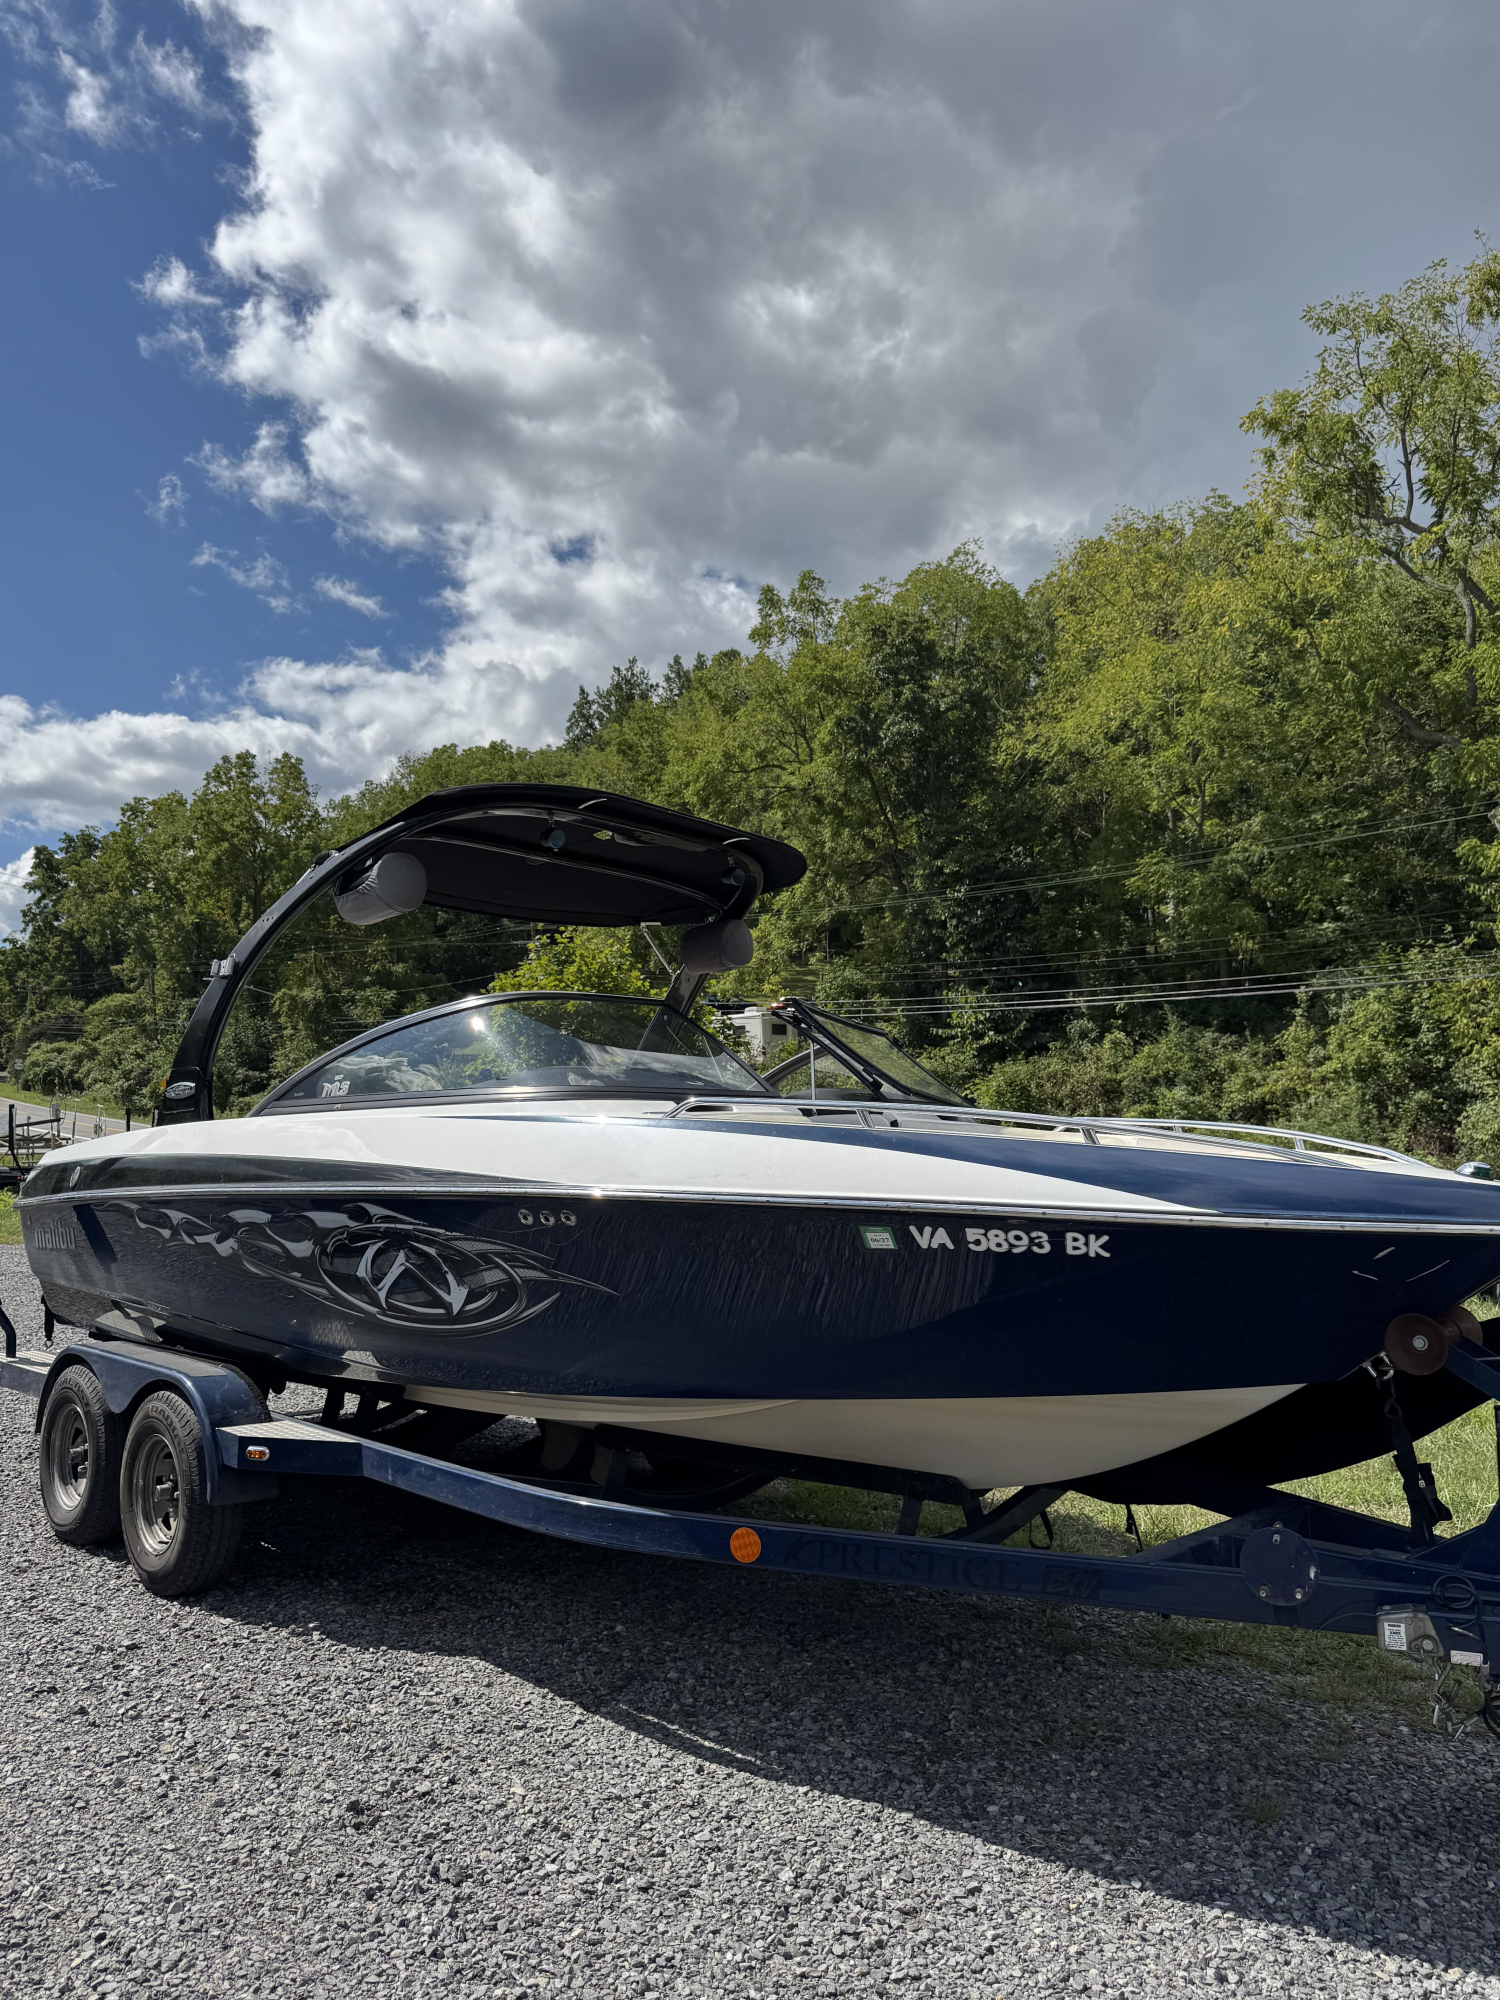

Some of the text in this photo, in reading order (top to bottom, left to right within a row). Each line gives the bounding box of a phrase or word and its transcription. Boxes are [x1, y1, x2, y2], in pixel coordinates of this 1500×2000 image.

[35, 1220, 76, 1250] malibu
[909, 1225, 1111, 1257] VA 5893 BK
[815, 1539, 1022, 1592] PRESTIGE
